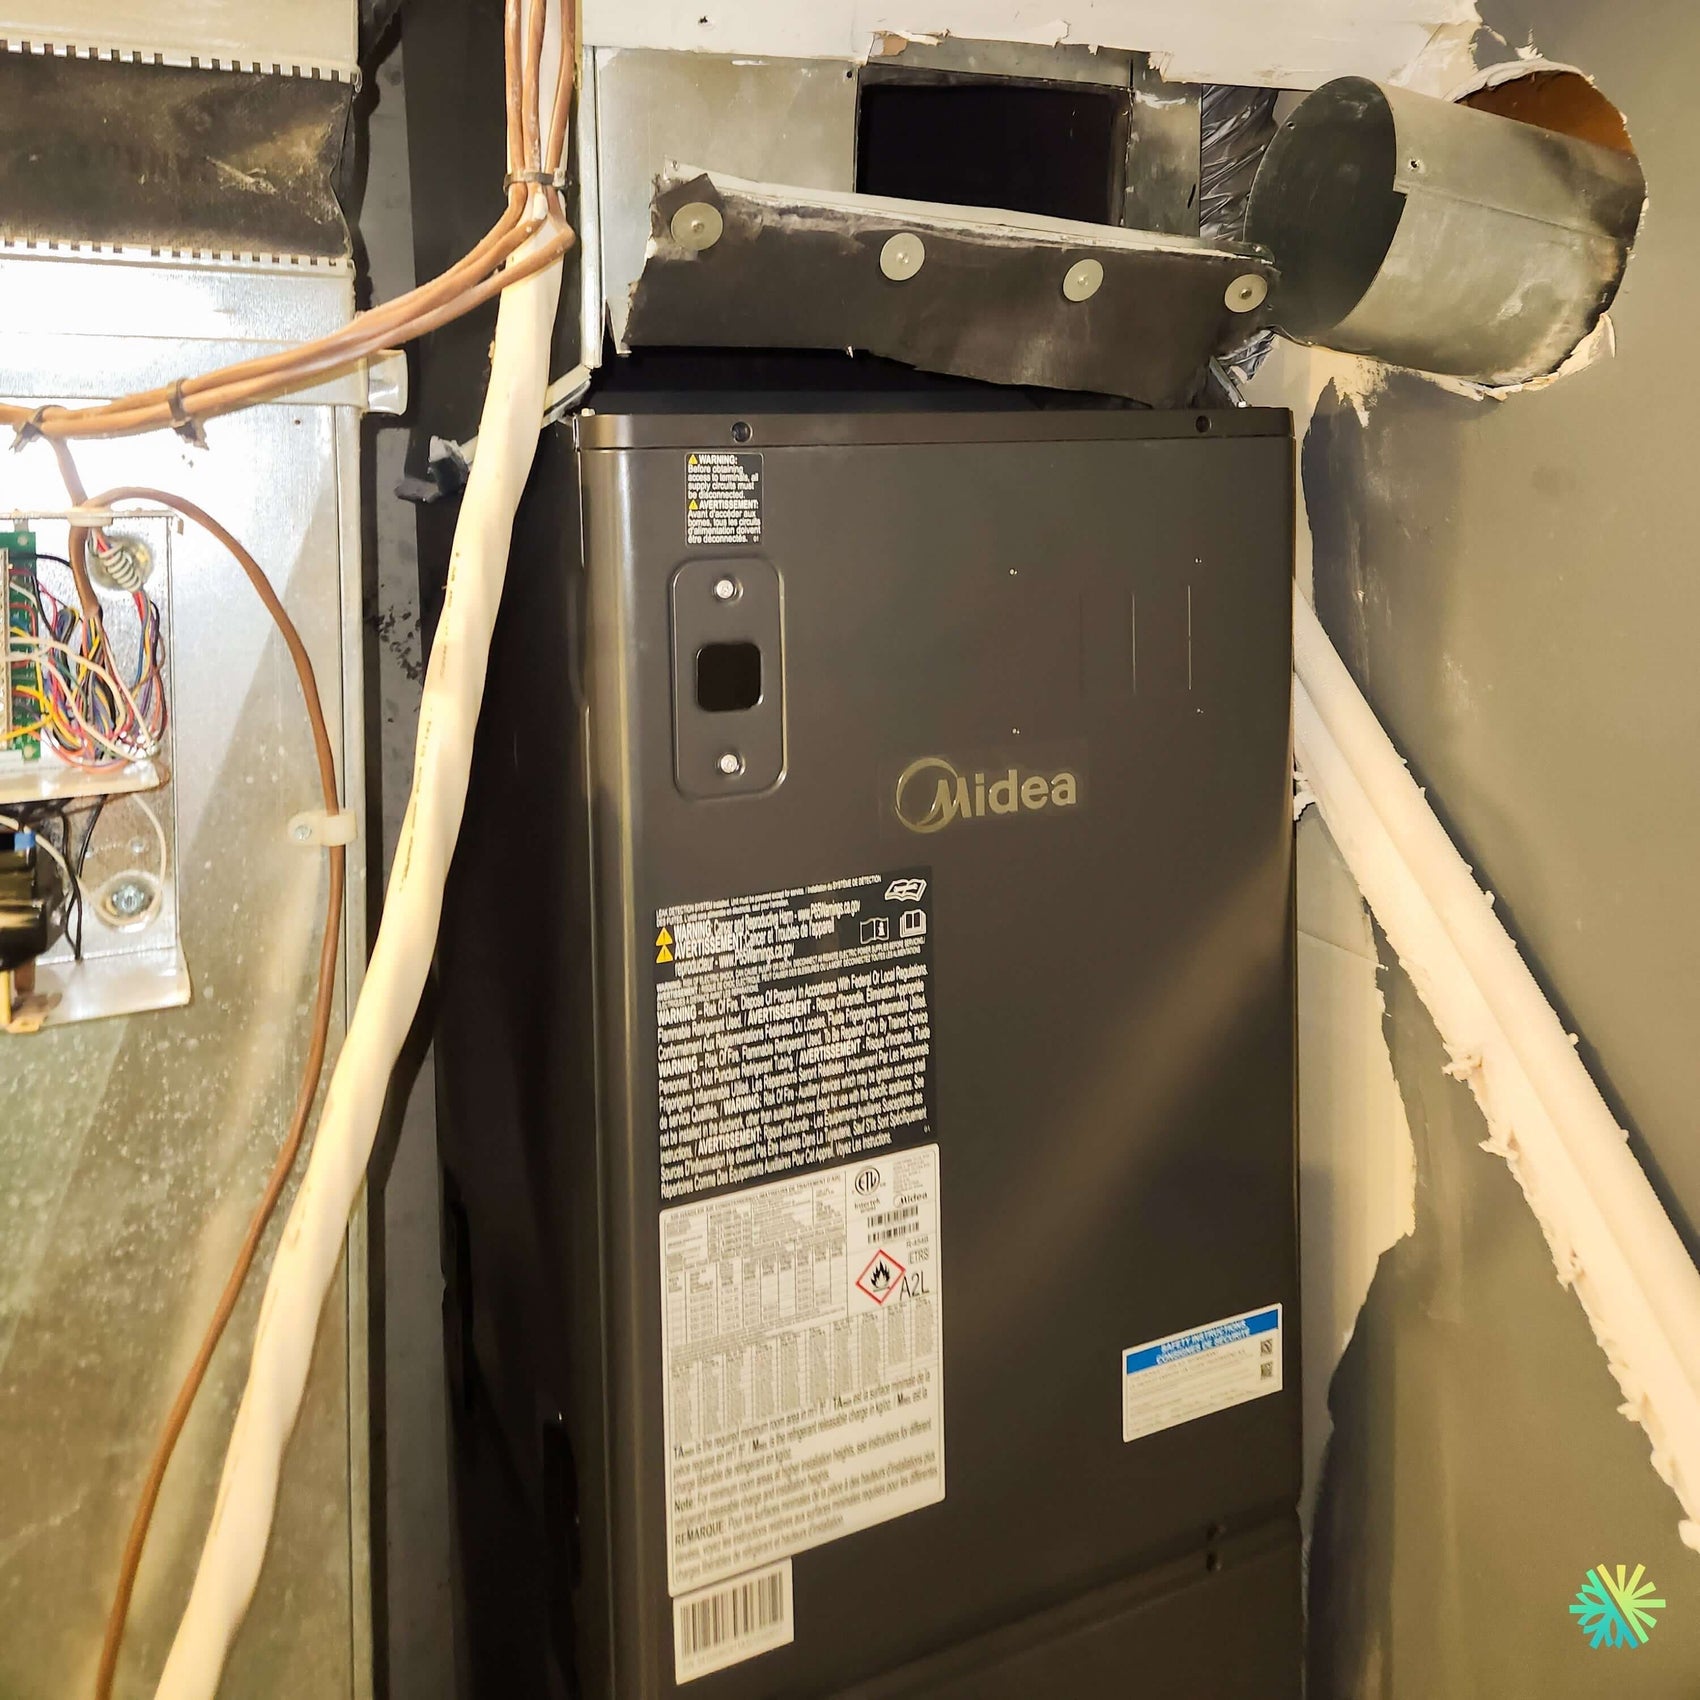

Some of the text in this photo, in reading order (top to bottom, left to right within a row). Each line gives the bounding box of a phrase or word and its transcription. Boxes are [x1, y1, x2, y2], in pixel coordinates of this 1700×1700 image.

[688, 465, 744, 476] Before obtaining
[699, 455, 738, 465] WARNING:
[688, 473, 711, 482] access
[712, 473, 719, 482] to
[688, 482, 754, 492] supply circuits must
[688, 490, 745, 499] be disconnected.
[699, 499, 759, 510] AVERTISSEMENT:
[688, 509, 708, 518] Avant
[744, 509, 756, 518] aux
[728, 518, 738, 527] les
[739, 518, 761, 527] circuits
[736, 526, 761, 535] doivent
[895, 757, 1077, 834] Midea
[673, 918, 713, 941] WARNING:
[713, 918, 733, 934] Cancer
[733, 913, 744, 931] and
[674, 931, 744, 960] AVERTISSEMENT:
[799, 920, 808, 937] de
[657, 1003, 696, 1026] WARNING
[703, 999, 717, 1017] Risk
[717, 998, 725, 1015] Of
[764, 989, 772, 1005] Of
[798, 983, 804, 999] In
[837, 974, 850, 992] With
[850, 970, 871, 989] Federal
[872, 969, 880, 985] Or
[880, 966, 895, 983] Local
[746, 998, 811, 1025] AVERTISSEMENT
[658, 1054, 697, 1078] WARNING
[704, 1050, 718, 1068] Risk
[718, 1048, 726, 1065] Of
[831, 1027, 840, 1042] Be
[865, 1019, 878, 1037] Only
[879, 1017, 887, 1035] By
[908, 1009, 928, 1026] Service
[692, 1072, 701, 1088] Do
[701, 1068, 713, 1086] Not
[799, 1038, 861, 1065] AVERTISSEMENT
[889, 1048, 899, 1063] Les
[723, 1092, 762, 1115] WARNING:
[763, 1089, 775, 1107] Risk
[775, 1087, 783, 1104] Of
[867, 1069, 875, 1084] be
[697, 1125, 762, 1155] AVERTISSEMENT:
[899, 1271, 930, 1301] A2L
